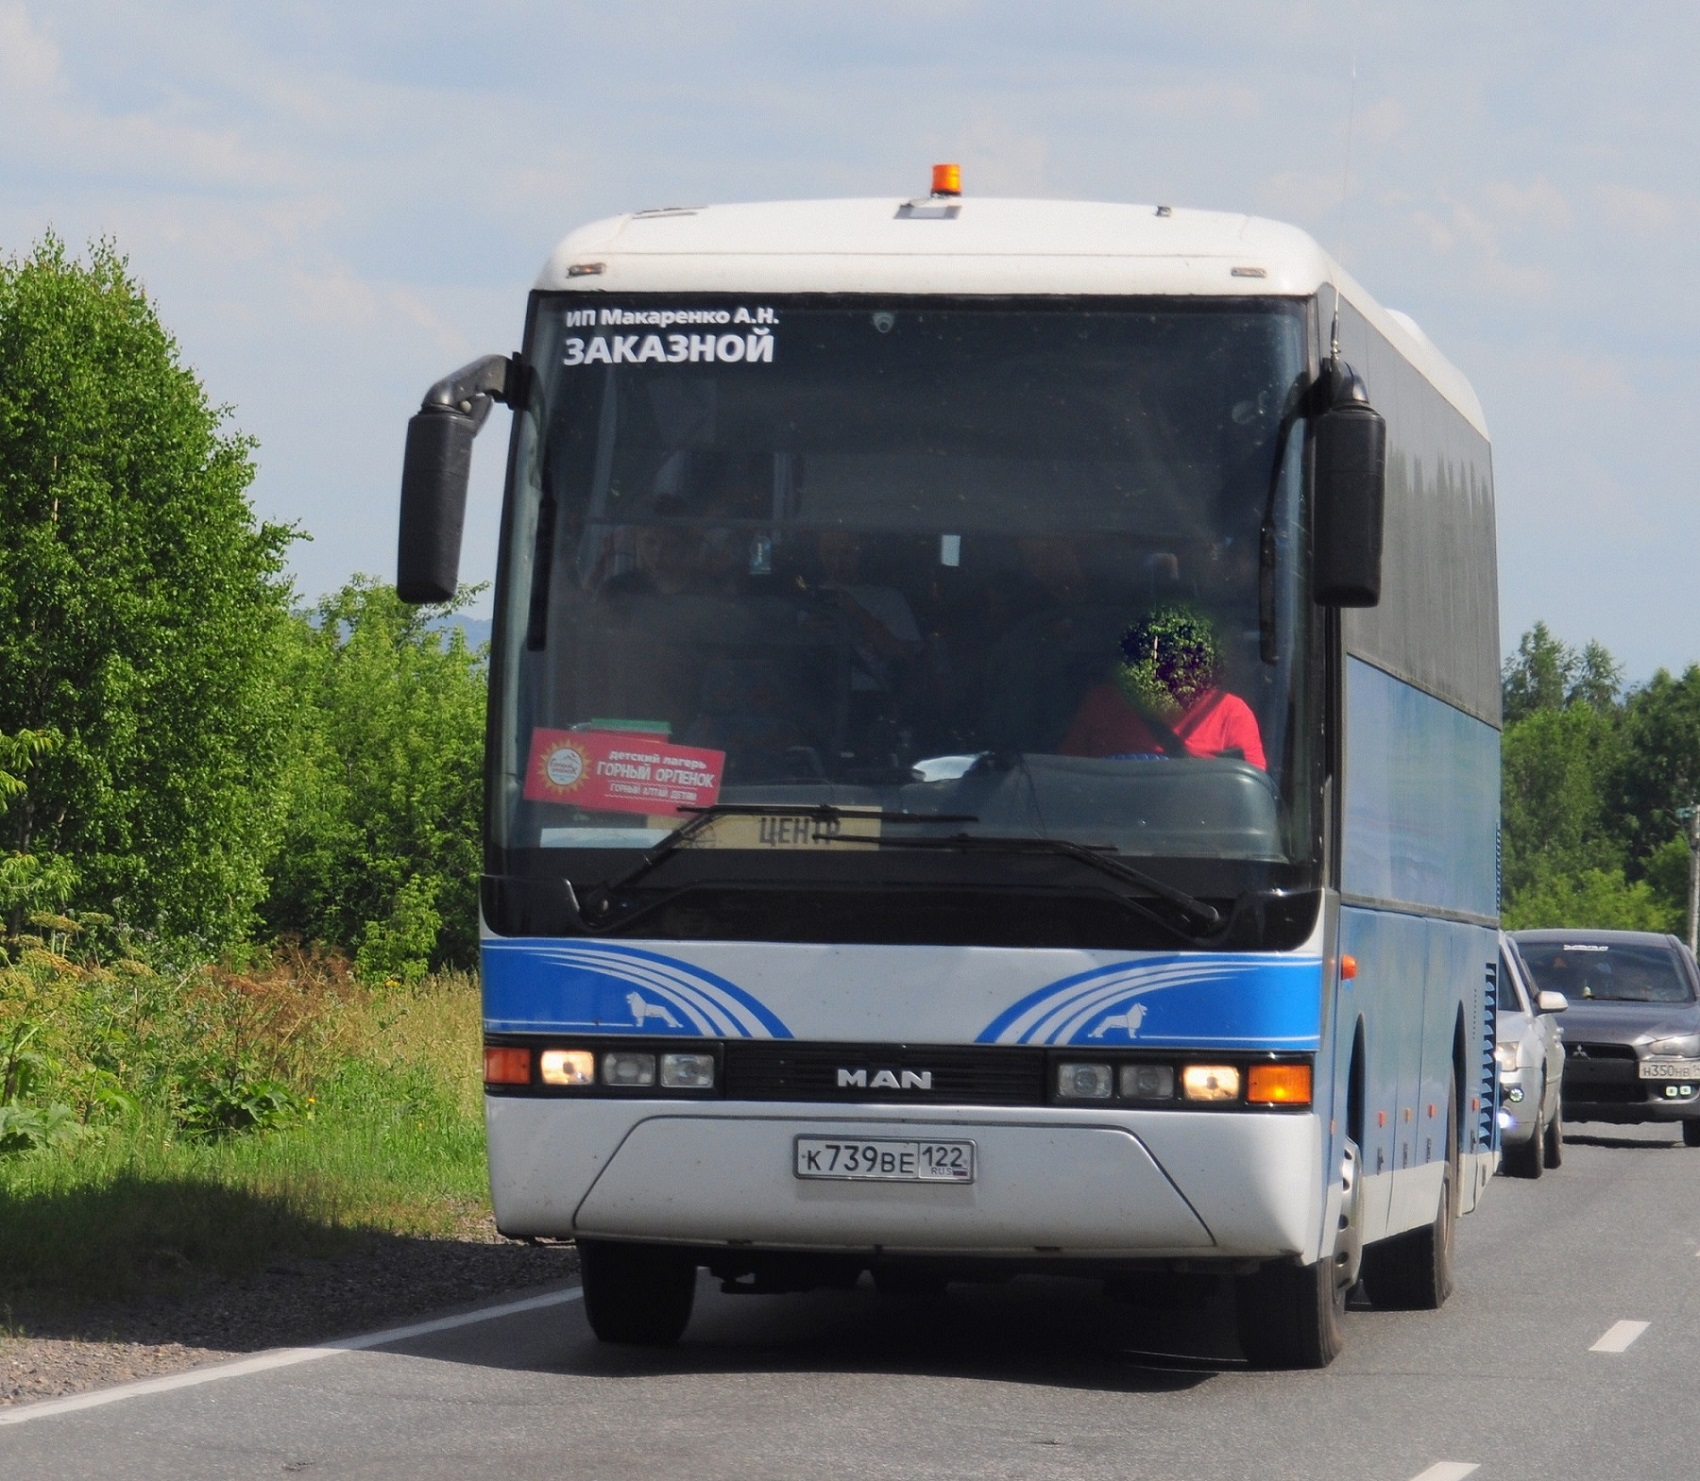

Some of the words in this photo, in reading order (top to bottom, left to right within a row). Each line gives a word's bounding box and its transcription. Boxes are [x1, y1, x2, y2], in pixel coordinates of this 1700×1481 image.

[565, 309, 597, 328] ИП
[600, 308, 731, 328] Макаренко
[733, 307, 780, 325] А.Н.
[562, 327, 775, 366] ЗАКАЗНОЙ
[608, 750, 661, 764] детский
[596, 761, 651, 781] ГОРНЫЙ
[837, 1068, 932, 1090] MAN
[931, 1167, 953, 1176] RUS
